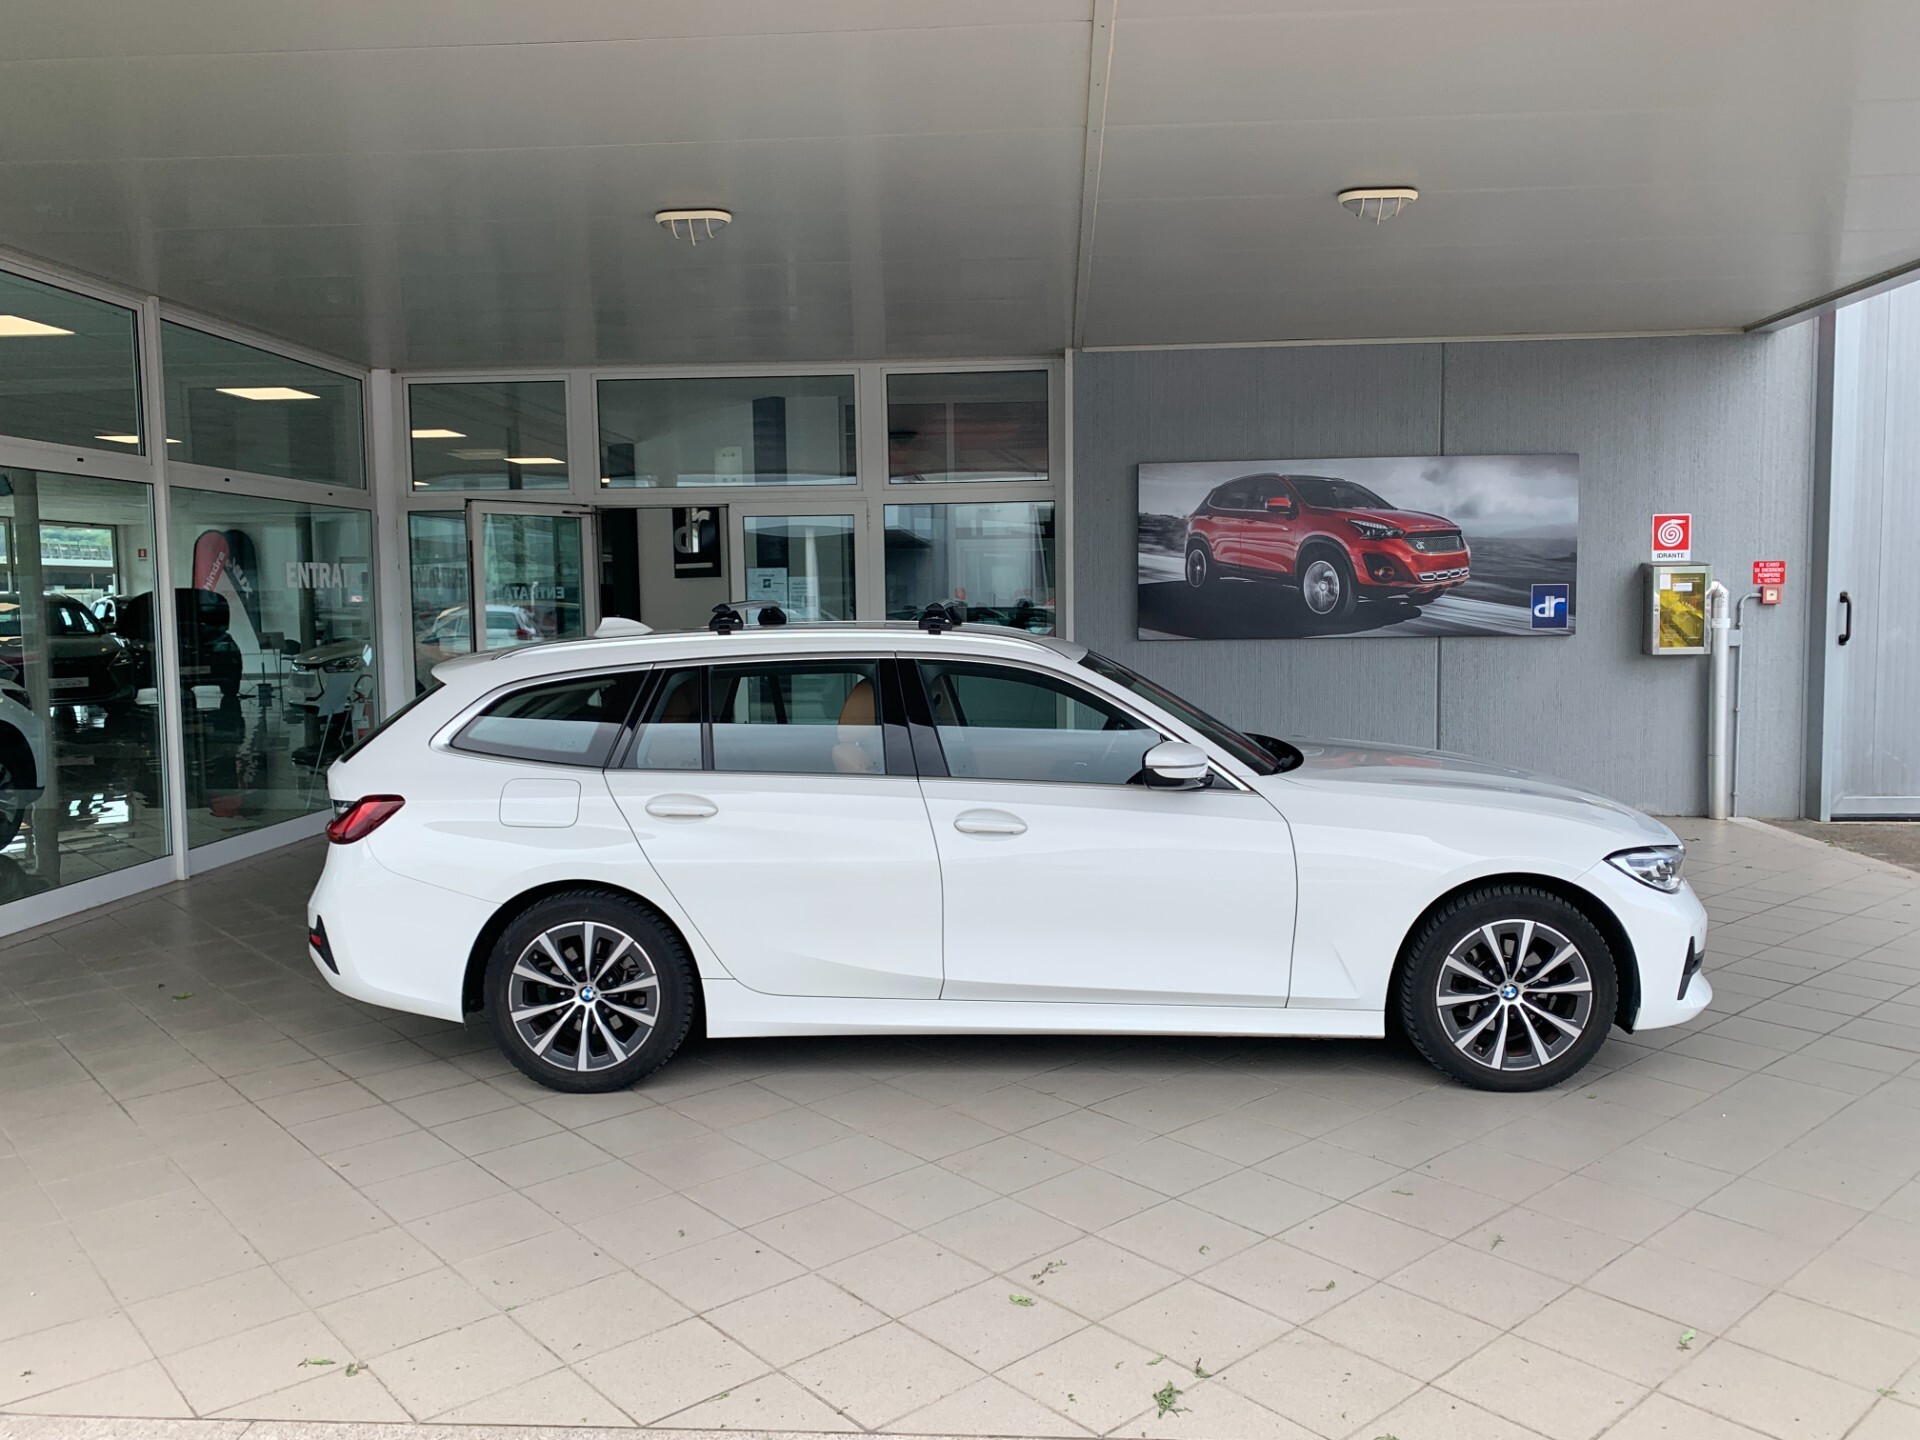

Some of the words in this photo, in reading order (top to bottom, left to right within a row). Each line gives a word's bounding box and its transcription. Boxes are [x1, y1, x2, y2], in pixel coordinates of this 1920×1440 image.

[203, 551, 226, 591] hindra
[286, 562, 356, 588] ENTRAT
[1533, 595, 1566, 618] dr
